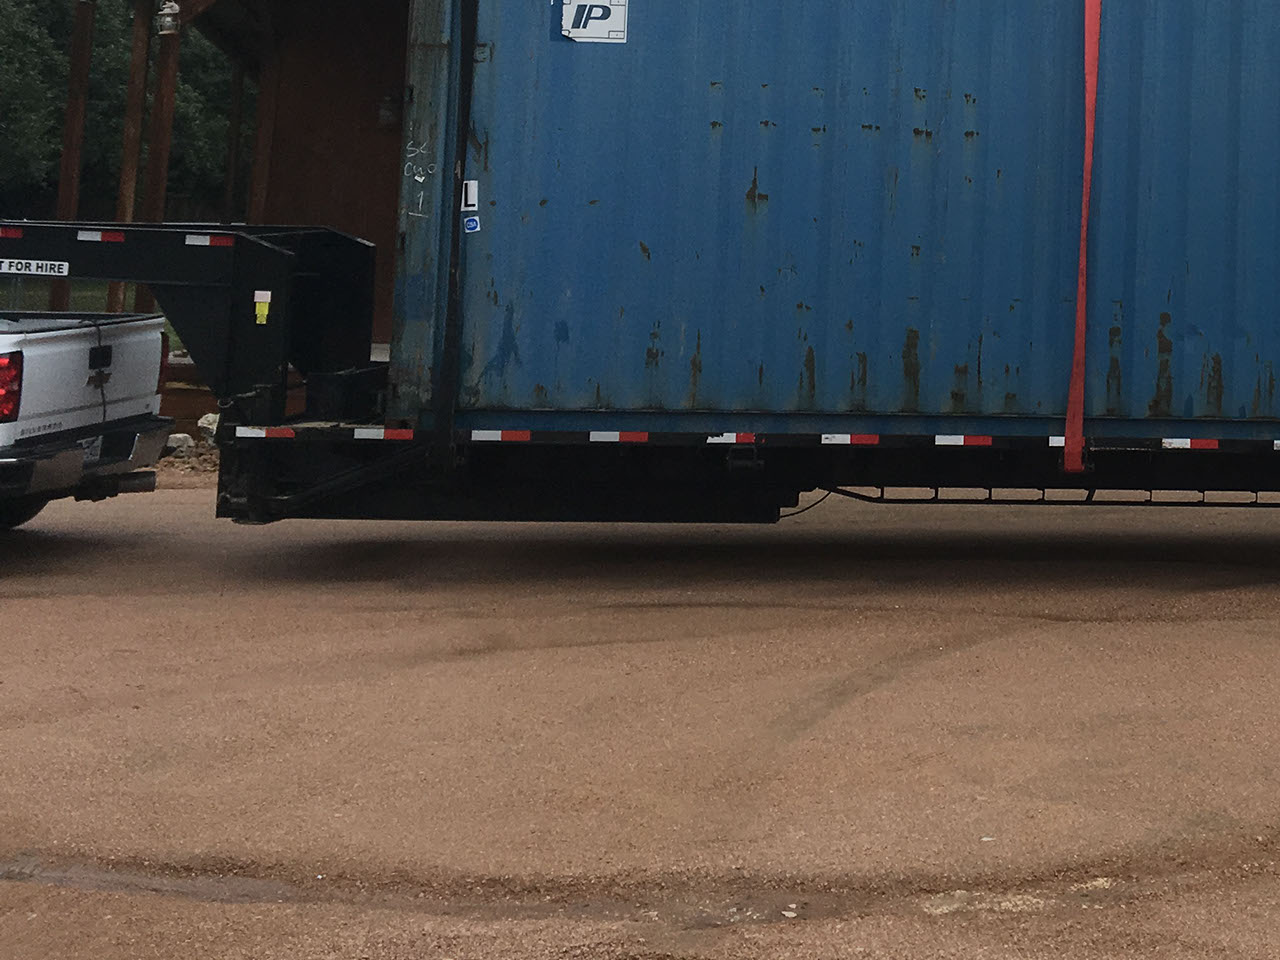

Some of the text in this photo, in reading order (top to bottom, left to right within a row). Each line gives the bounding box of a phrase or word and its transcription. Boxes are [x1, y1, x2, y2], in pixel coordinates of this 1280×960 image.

[570, 4, 612, 29] IP
[463, 182, 476, 208] L
[8, 260, 32, 272] FOR
[35, 262, 65, 274] HIRE
